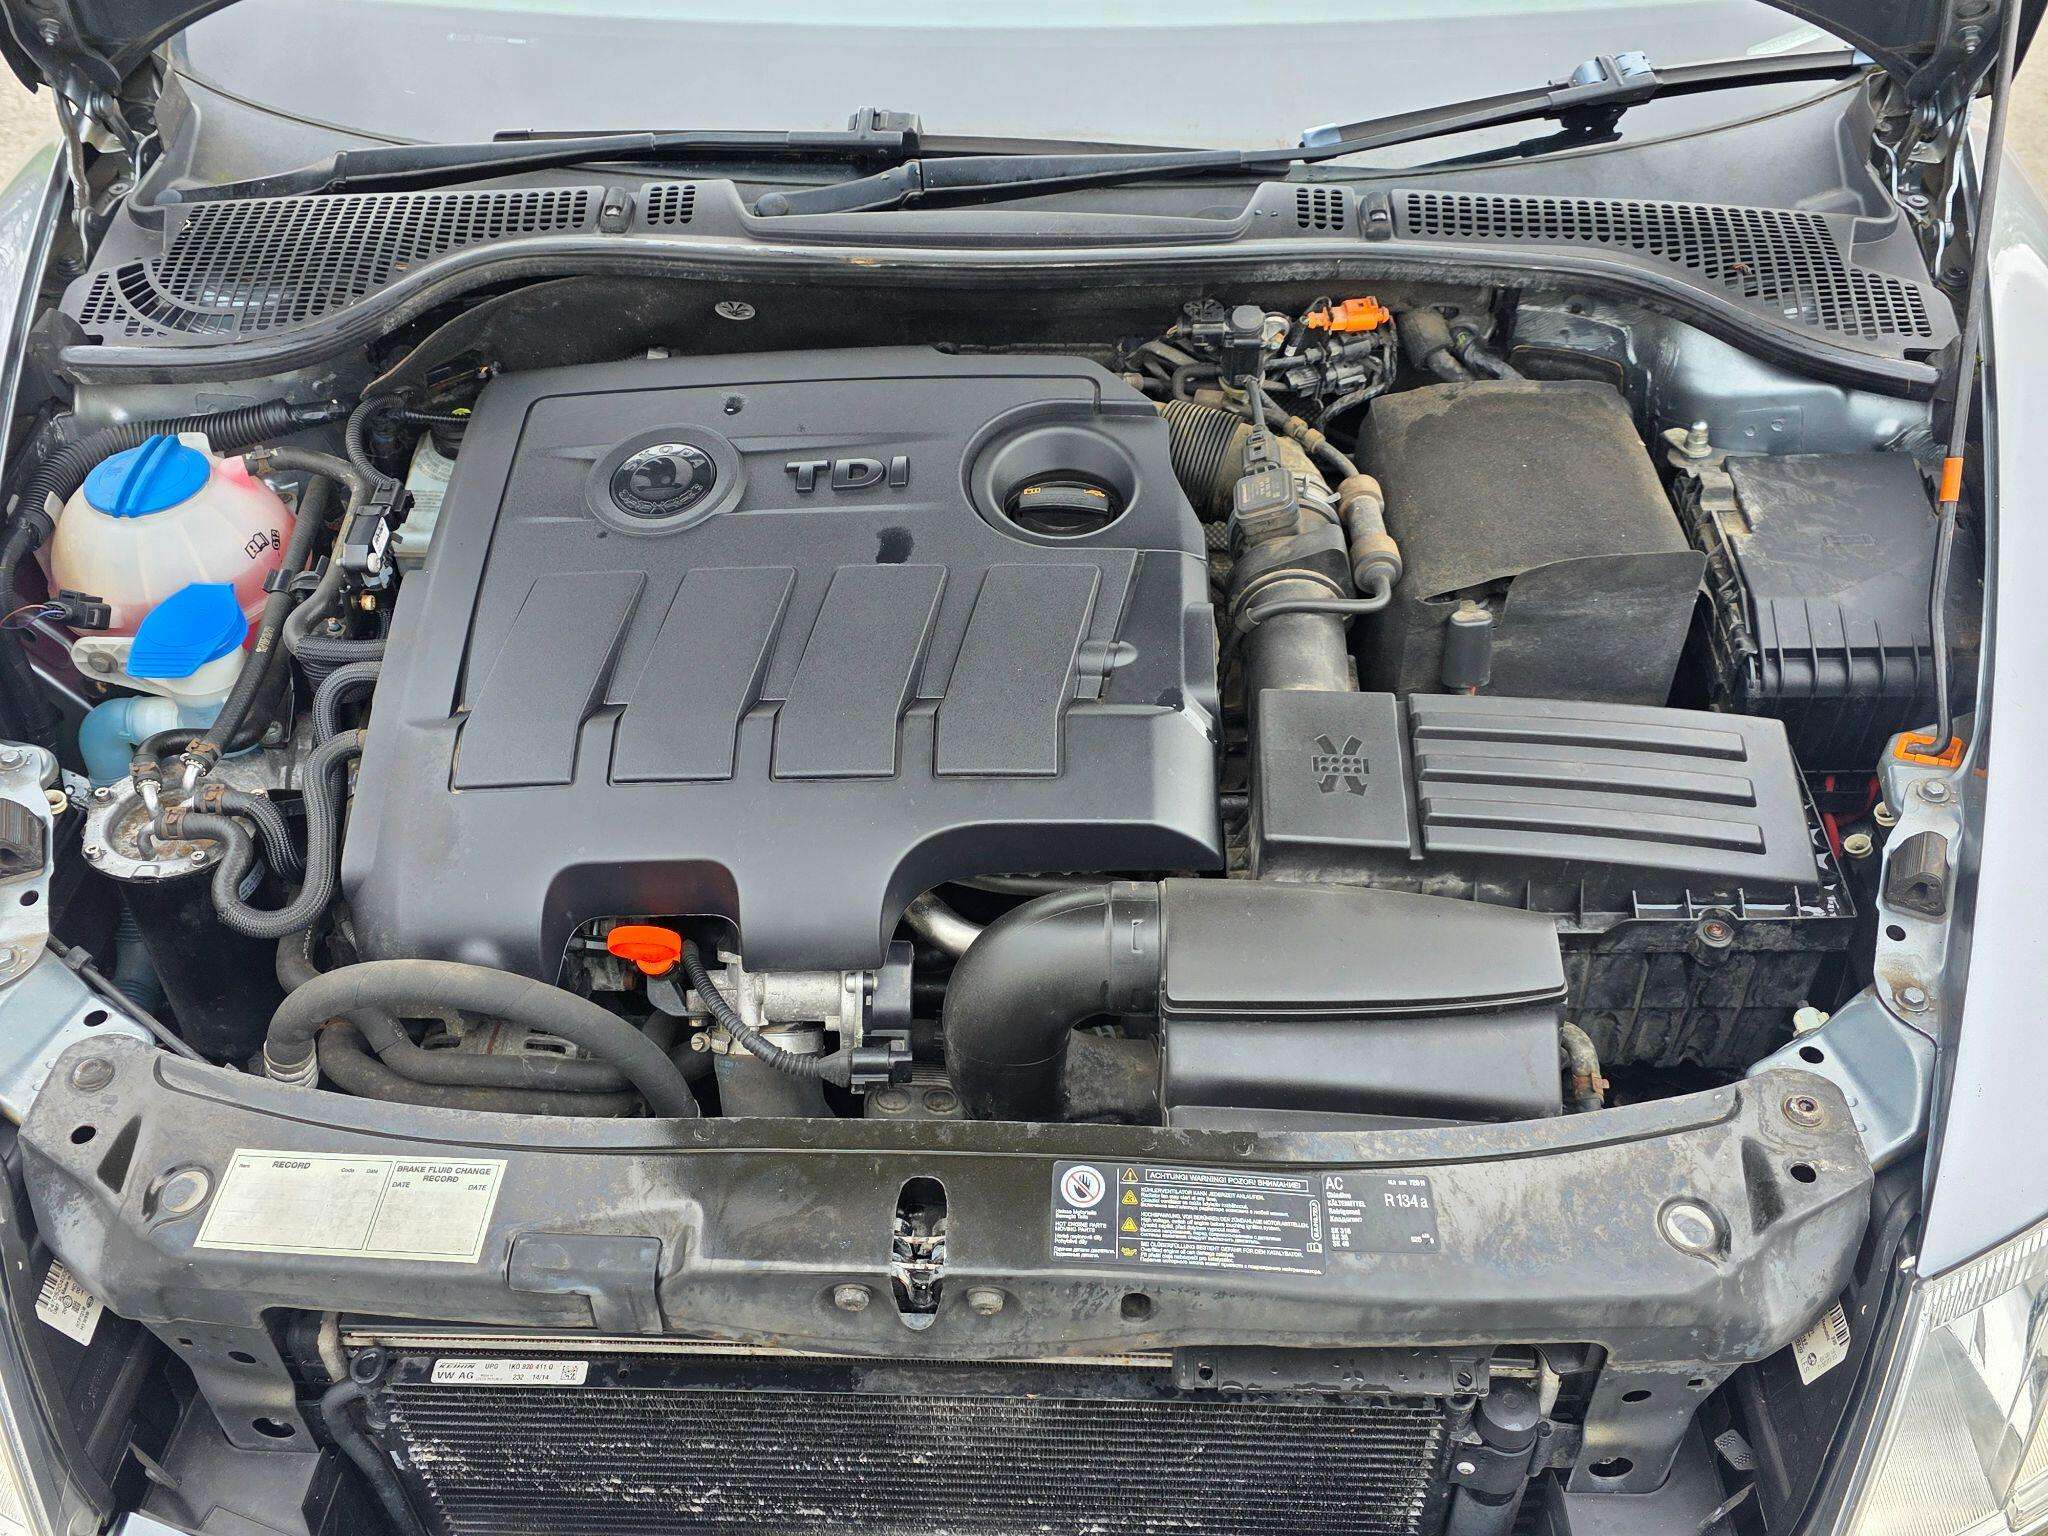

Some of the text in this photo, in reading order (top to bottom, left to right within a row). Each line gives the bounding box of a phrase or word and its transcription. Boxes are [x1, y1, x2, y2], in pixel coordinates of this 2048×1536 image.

[784, 456, 910, 493] TDI
[272, 1160, 311, 1170] RECORD
[396, 1165, 492, 1176] BRAKE FLUID CHANGE
[422, 1175, 459, 1183] RECORD
[1325, 1177, 1343, 1190] AC
[1384, 1193, 1429, 1209] R 134 a
[437, 1371, 455, 1379] VW
[458, 1371, 474, 1379] AG
